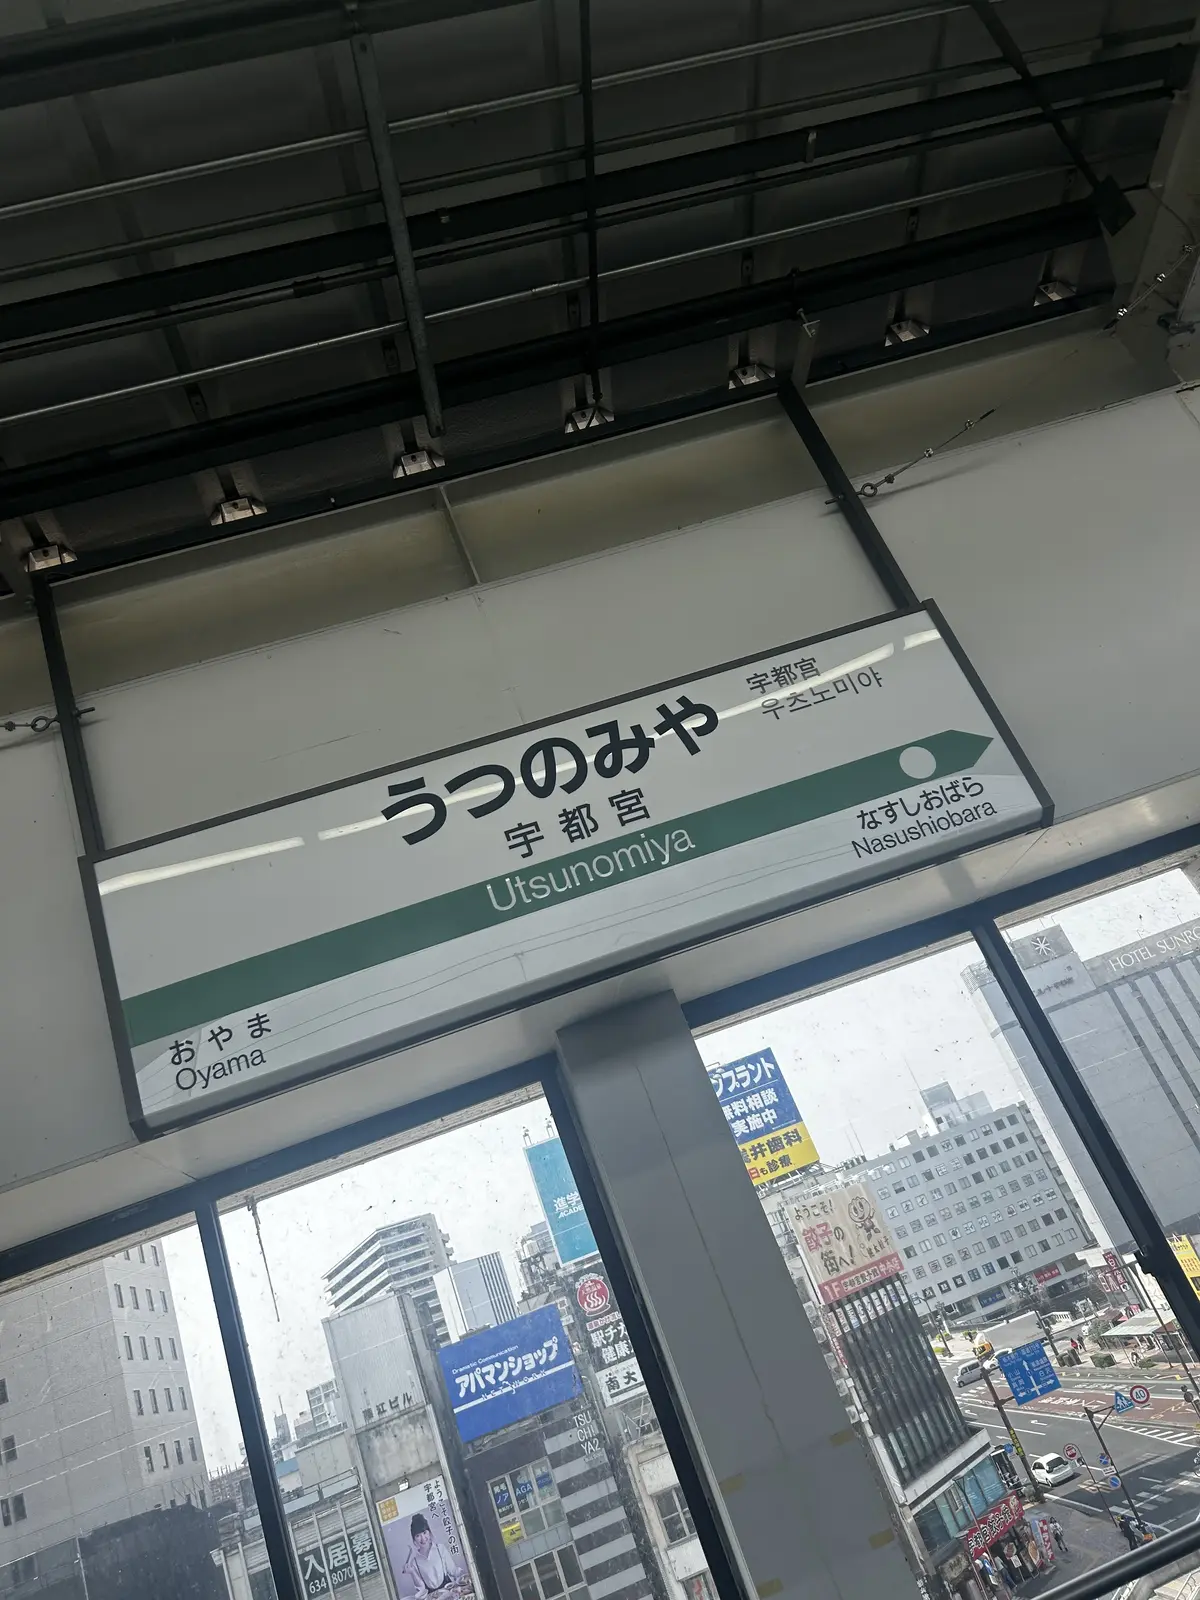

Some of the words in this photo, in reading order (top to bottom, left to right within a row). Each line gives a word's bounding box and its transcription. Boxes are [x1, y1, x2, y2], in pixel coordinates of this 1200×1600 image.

[760, 666, 883, 720] 우츠노미야
[381, 695, 719, 846] うつのみや
[856, 776, 984, 830] なすしおばら
[504, 787, 651, 859] 宇都宮
[851, 801, 998, 858] Nasushiobara
[486, 829, 696, 911] Utsunomiya
[1108, 946, 1157, 972] HOTEL
[169, 1012, 272, 1066] おやま
[175, 1048, 267, 1091] Oyama
[731, 1108, 778, 1137] 実施中
[452, 1360, 477, 1375] Dramatic
[477, 1344, 519, 1364] Communication
[455, 1336, 558, 1398] アパマンショップ
[601, 1340, 634, 1365] 健康
[1134, 1388, 1146, 1400] 40
[572, 1410, 592, 1428] TSU
[581, 1438, 600, 1456] YA2
[423, 1483, 439, 1519] 宇都宮へ
[515, 1483, 533, 1496] AGA
